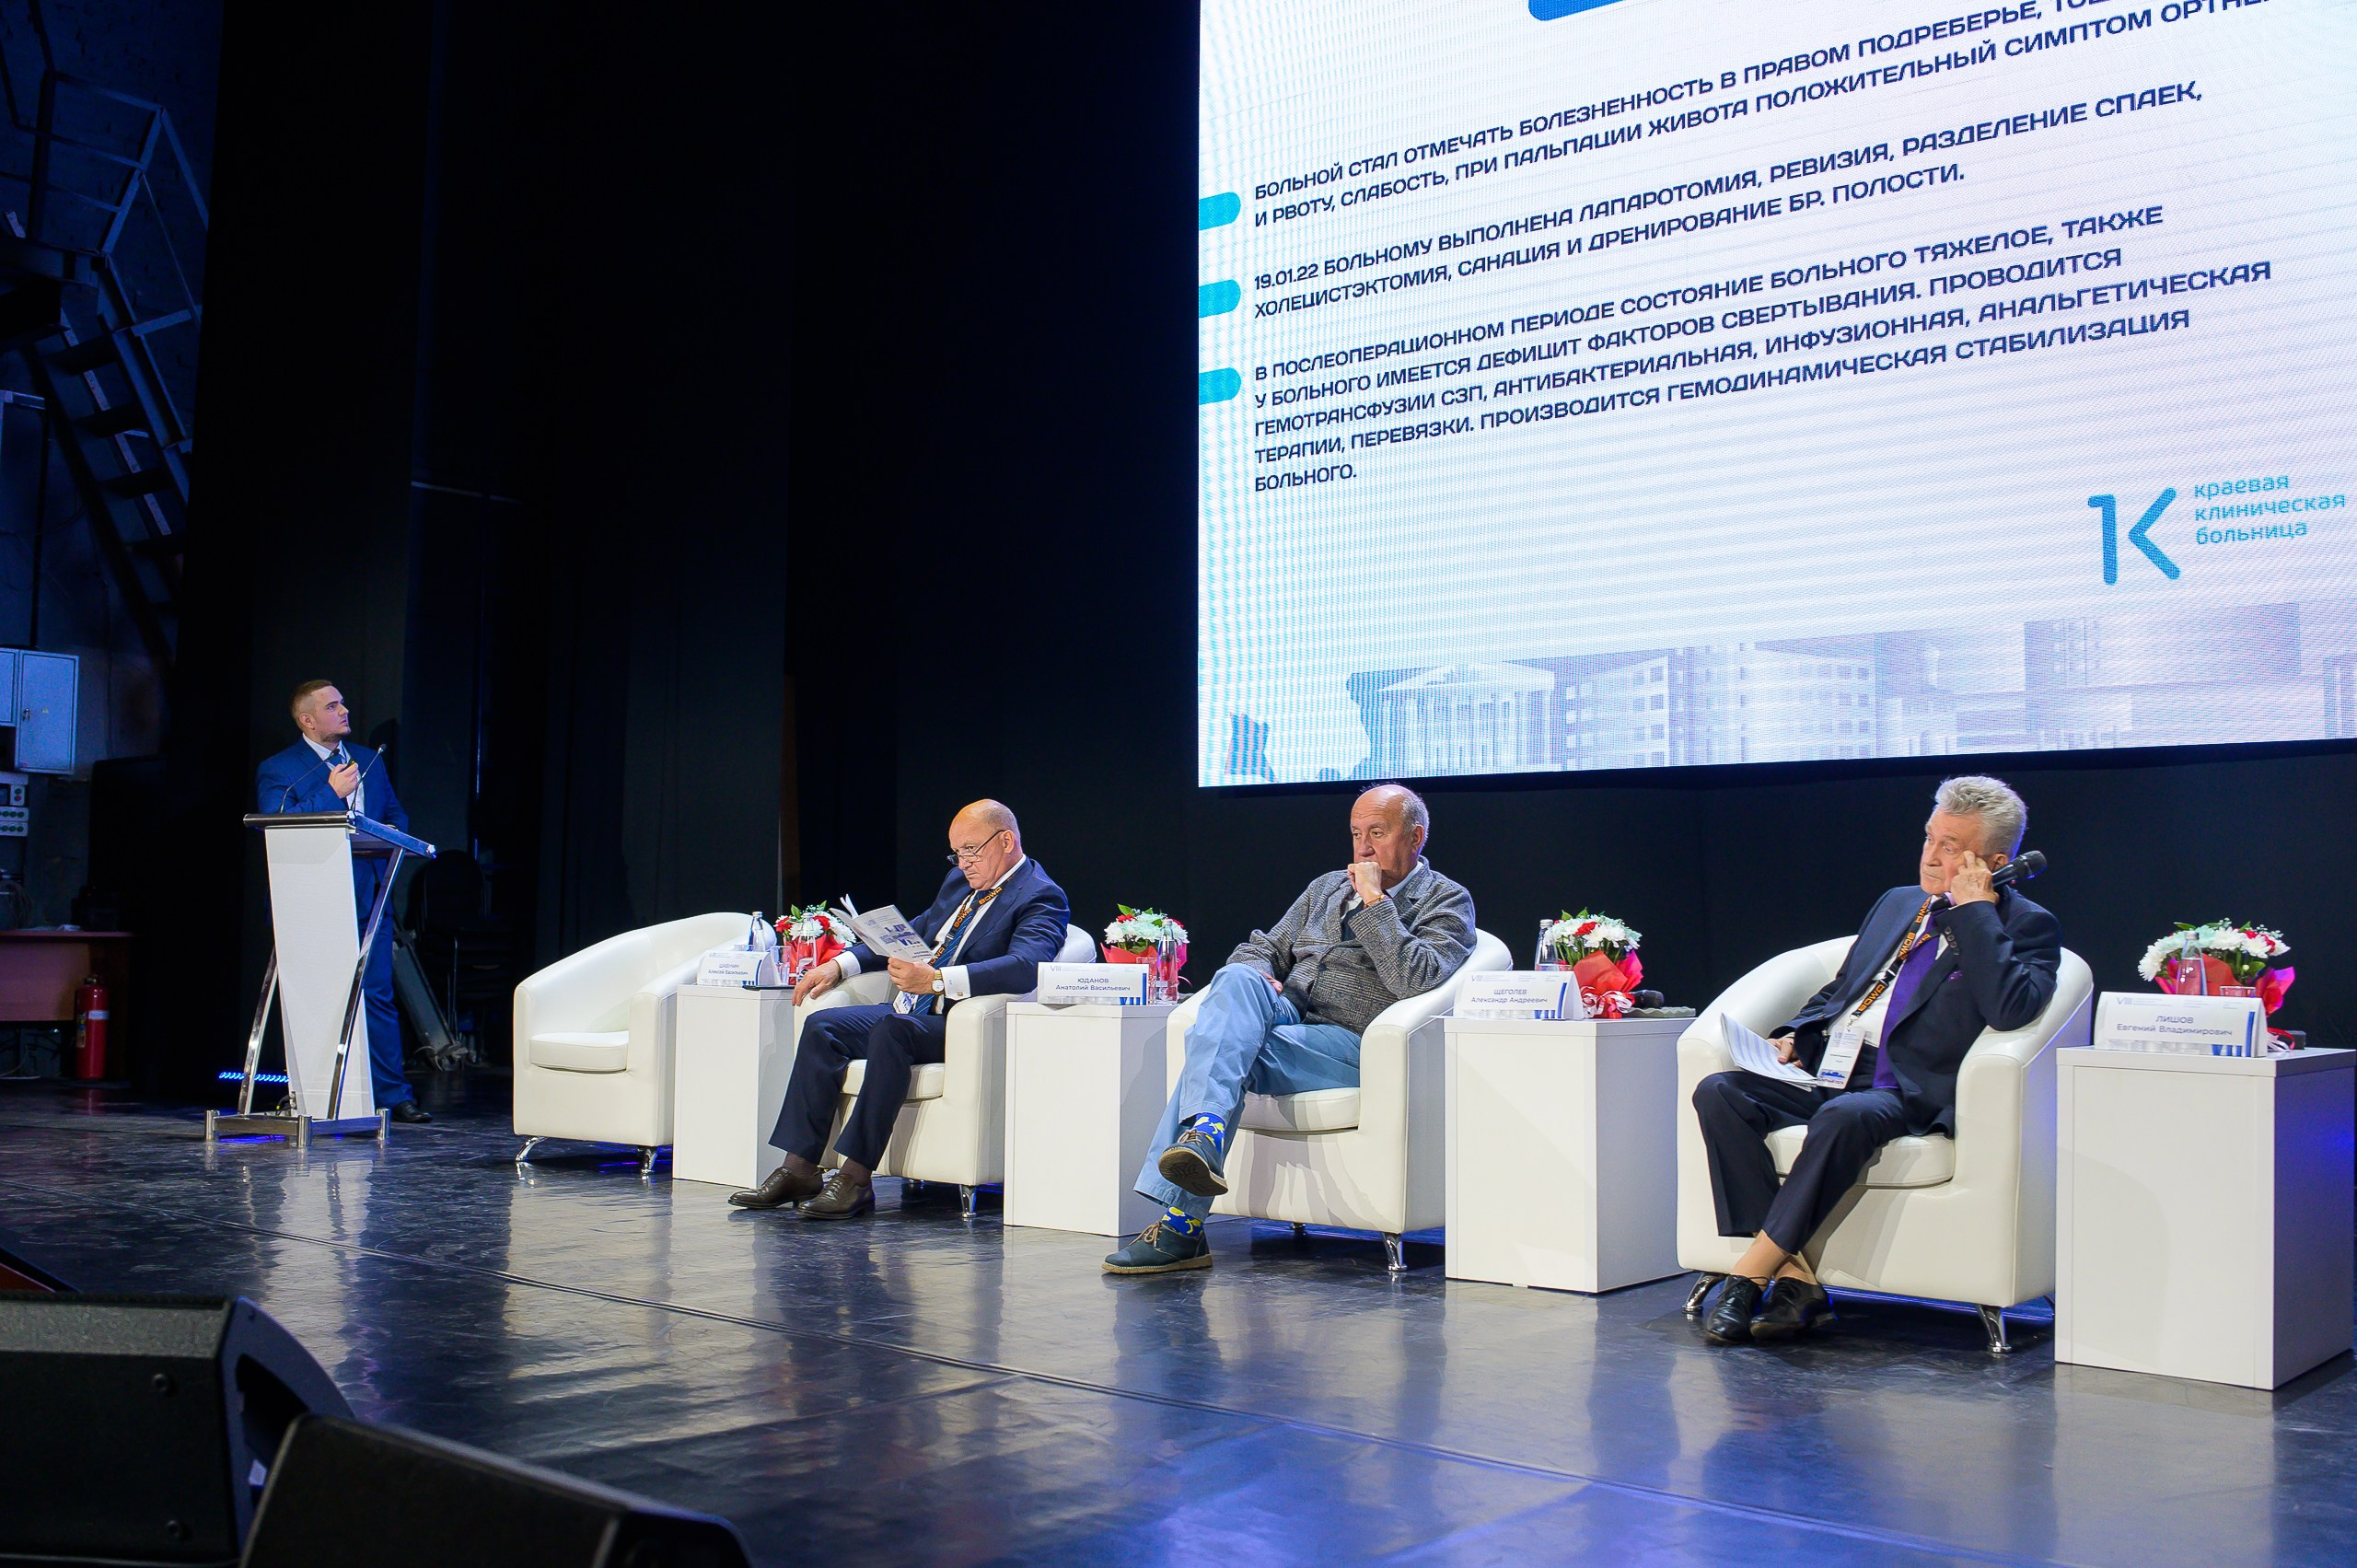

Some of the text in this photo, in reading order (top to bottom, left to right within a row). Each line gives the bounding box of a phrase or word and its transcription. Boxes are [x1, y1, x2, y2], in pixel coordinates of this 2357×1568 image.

[1255, 212, 1267, 226] И
[1273, 195, 1336, 223] РВОТУ,
[1341, 171, 1449, 206] СЛАБОСТЬ,
[1456, 157, 1497, 180] ПРИ
[1504, 124, 1642, 168] ПАЛЬПАЦИИ
[1649, 99, 1747, 136] ЖИВОТА
[1757, 43, 1995, 112] ПОЛОЖИТЕЛЬНЫЙ
[2005, 9, 2152, 56] СИМПТОМ
[1256, 0, 2041, 200] БОЛЬНОЙ СТАЛ ОТМЕЧАТЬ БОЛЕЗНЕННОСТЬ В ПРАВОМ ПОДРЕБЕРЬЕ,
[1255, 81, 2202, 290] 19.01.22 БОЛЬНОМУ ВЫПОЛНЕНА ЛАПАРОТОМИЯ, РЕВИЗИЯ, РАЗДЕЛЕНИЕ СПАЕК,
[1255, 164, 1965, 318] ХОЛЕЦИСТЭКТОМИЯ, САНАЦИЯ И ДРЕНИРОВАНИЕ БР. ПОЛОСТИ.
[1255, 249, 2121, 409] У БОЛЬНОГО ИМЕЕТСЯ ДЕФИЦИТ ФАКТОРОВ СВЕРТЫВАНИЯ. ПРОВОДИТСЯ
[1255, 261, 2271, 436] ГЕМОТРАНСФУЗИИ СЗП, АНТИБАКТЕРИАЛЬНАЯ, ИНФУЗИОННАЯ, АНАЛЬГЕТИЧЕСКАЯ
[1256, 206, 2164, 380] В ПОСЛЕОПЕРАЦИОННОМ ПЕРИОДЕ СОСТОЯНИЕ БОЛЬНОГО ТЯЖЕЛОЕ, ТАКЖЕ
[1255, 309, 2189, 463] ТЕРАПИИ, ПЕРЕВЯЗКИ. ПРОИЗВОДИТСЯ ГЕМОДИНАМИЧЕСКАЯ СТАБИЛИЗАЦИЯ
[1255, 464, 1356, 492] БОЛЬНОГО.
[2194, 475, 2289, 500] краевая
[2195, 494, 2346, 522] клиническая
[2196, 520, 2308, 545] больница
[978, 886, 1003, 905] BOWA
[2117, 1023, 2233, 1036] Евгений Владимирович
[2155, 1015, 2194, 1024] ЛИШОВ
